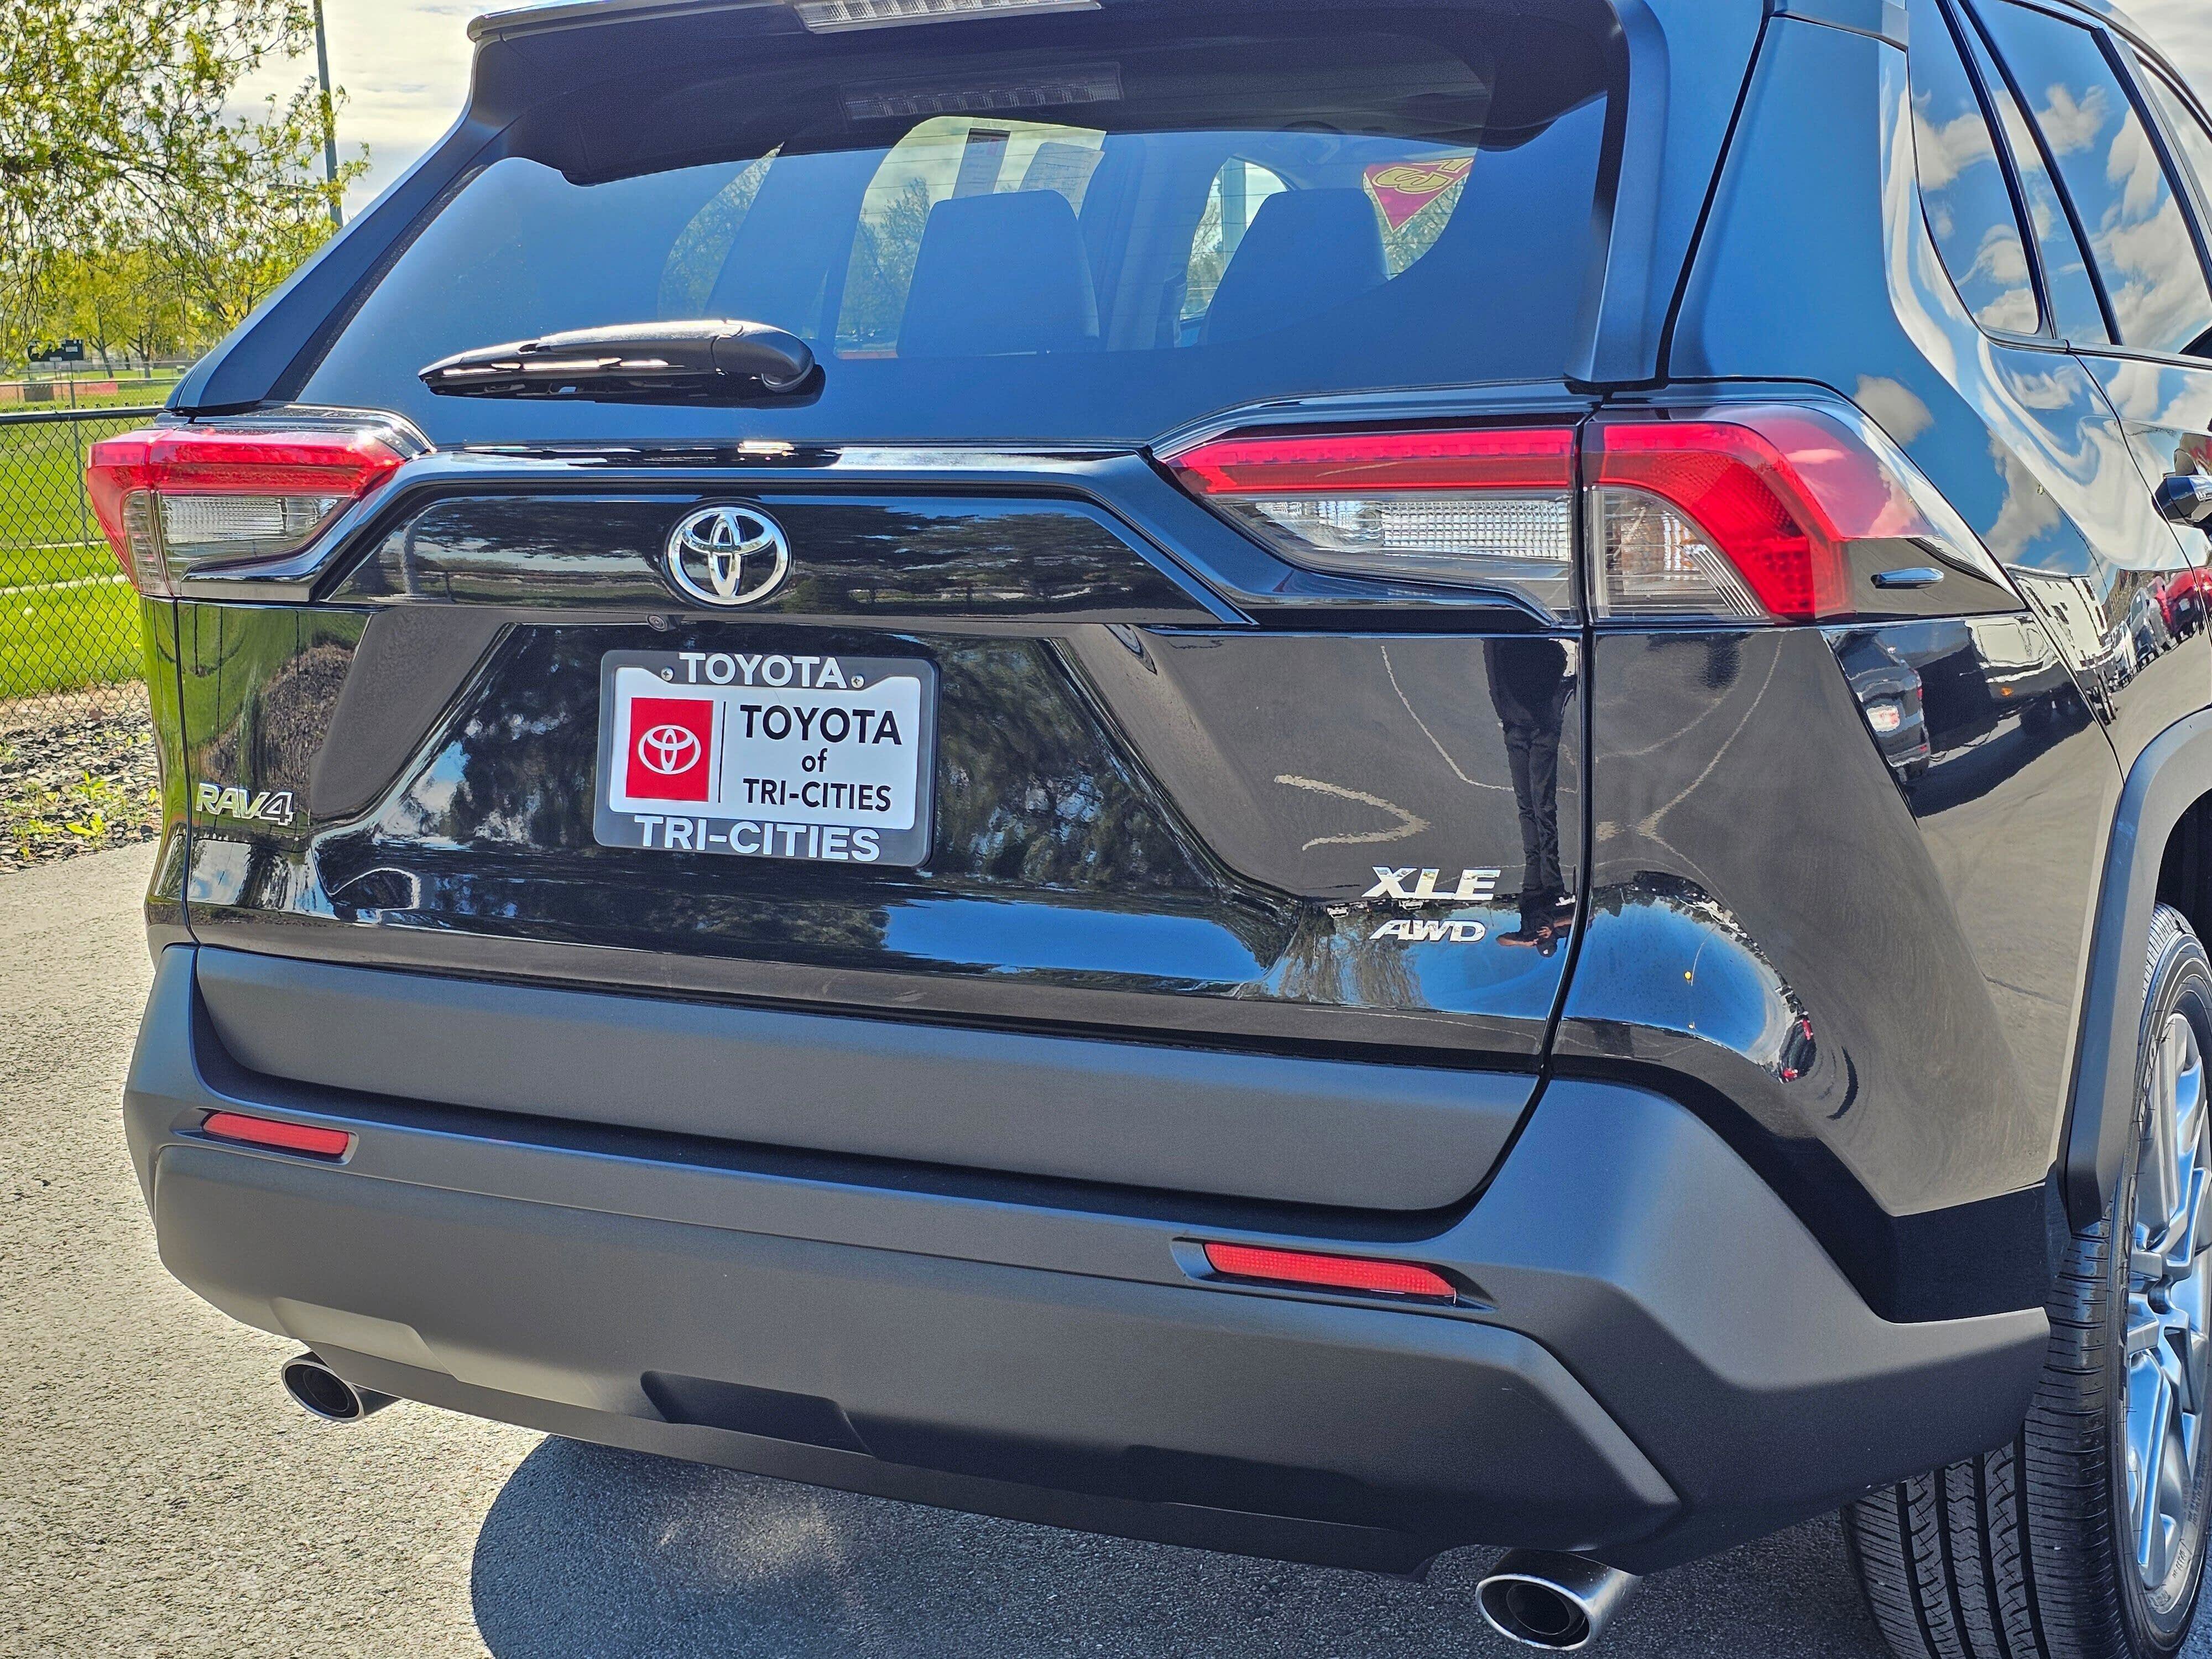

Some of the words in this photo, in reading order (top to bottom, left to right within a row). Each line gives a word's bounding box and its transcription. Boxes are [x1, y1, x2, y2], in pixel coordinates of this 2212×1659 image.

[679, 651, 847, 689] TOYOTA
[740, 704, 903, 745] TOYOTA
[801, 748, 828, 773] of
[196, 782, 295, 826] RAV4
[743, 778, 892, 812] TRI-CITIES
[634, 815, 880, 863] TRI-CITIES
[1361, 865, 1501, 901] XLE
[1369, 919, 1486, 942] AWD
